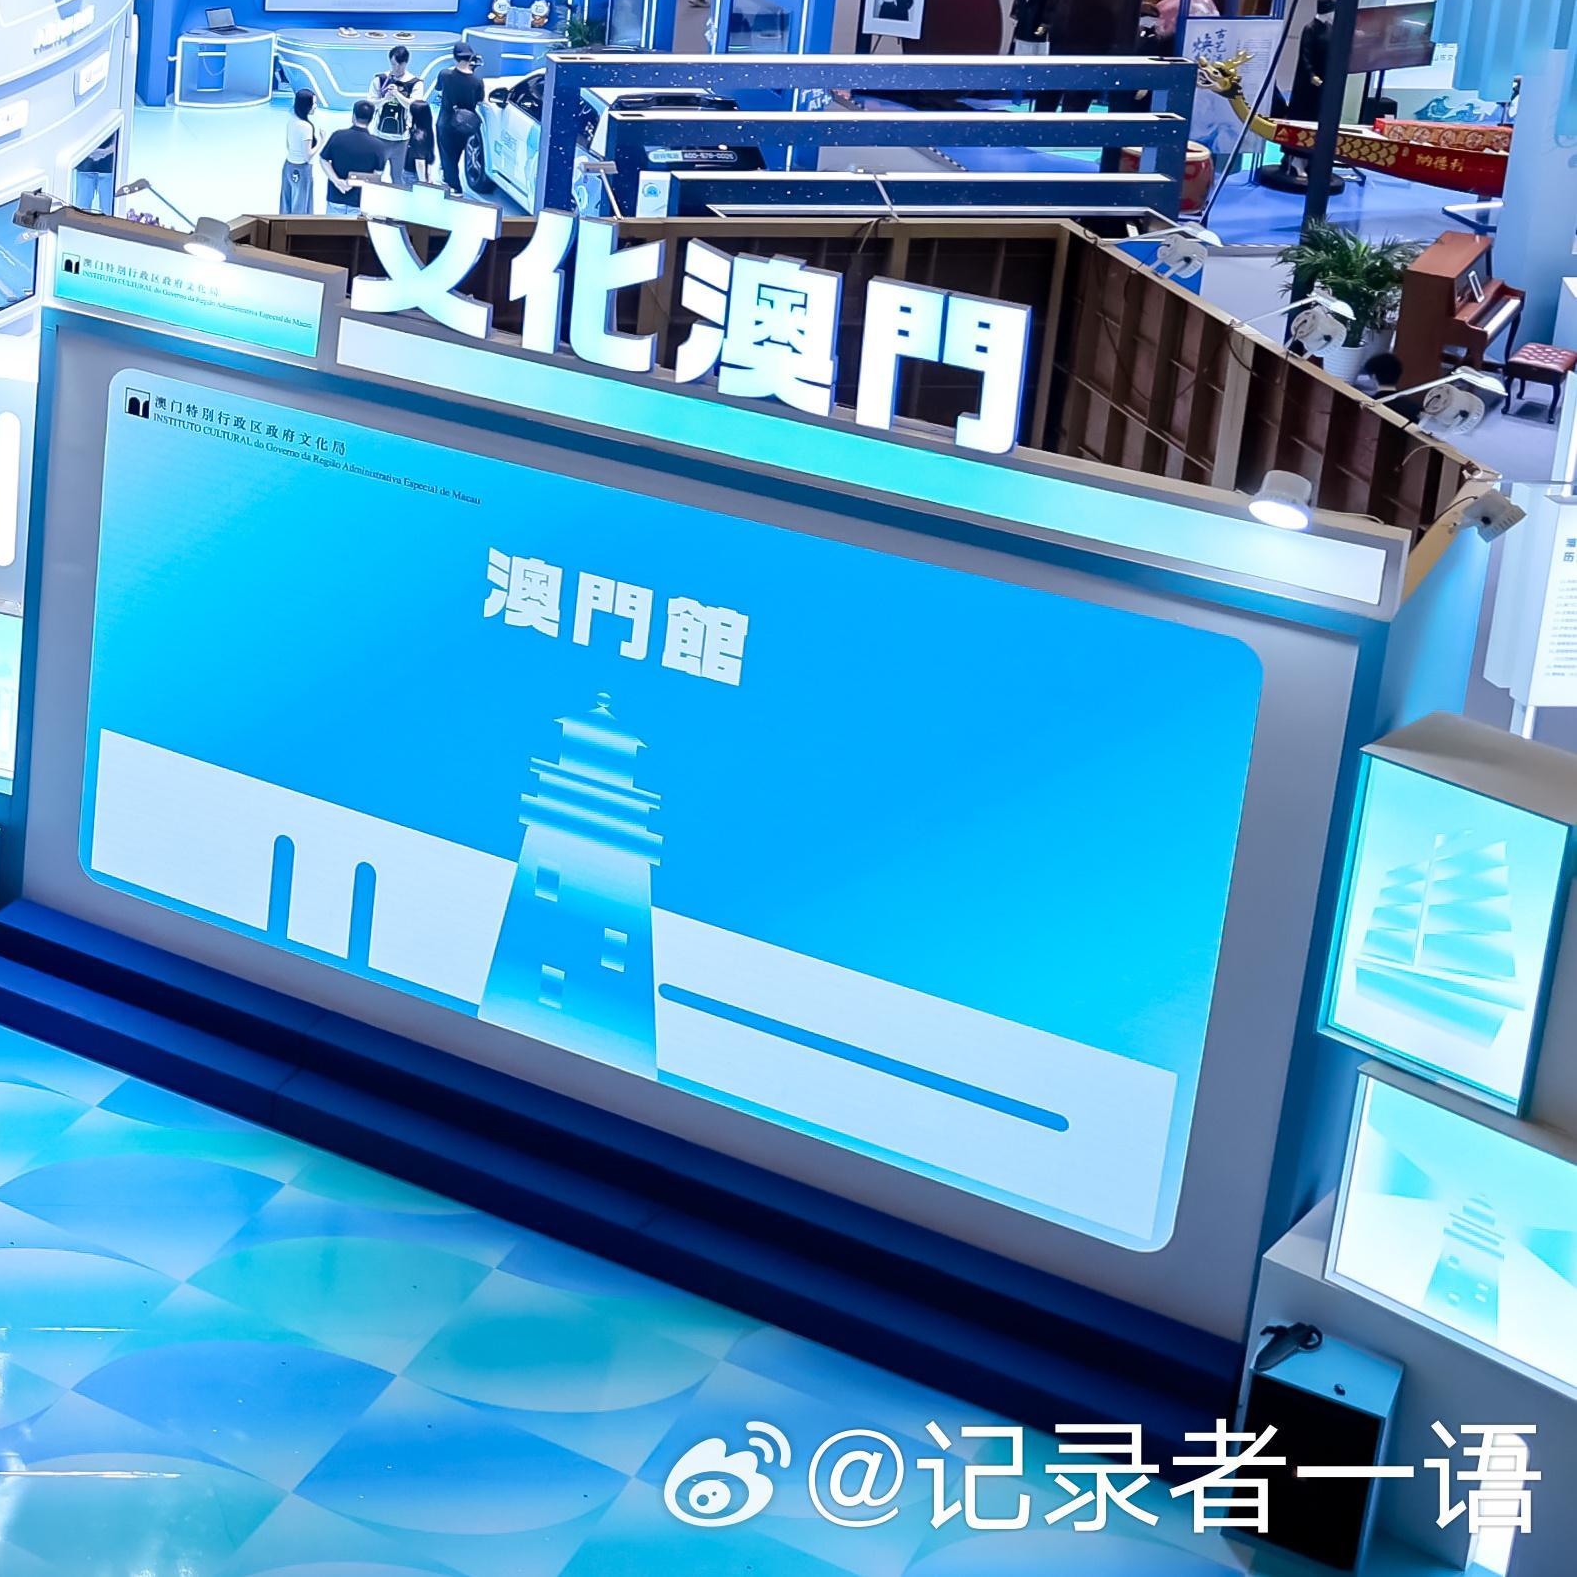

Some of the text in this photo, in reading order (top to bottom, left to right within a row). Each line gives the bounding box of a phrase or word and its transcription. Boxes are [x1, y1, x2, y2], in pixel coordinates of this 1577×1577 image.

[351, 180, 1034, 456] 文化澳門
[153, 412, 202, 433] INSTITUTO
[203, 425, 253, 446] CULTURAL
[253, 438, 265, 449] do
[265, 441, 300, 459] Governo
[301, 450, 312, 462] da
[343, 461, 402, 485] Administrativa
[403, 477, 438, 496] Especial
[439, 486, 451, 497] de
[451, 488, 482, 506] Macau
[483, 547, 749, 688] 澳門館
